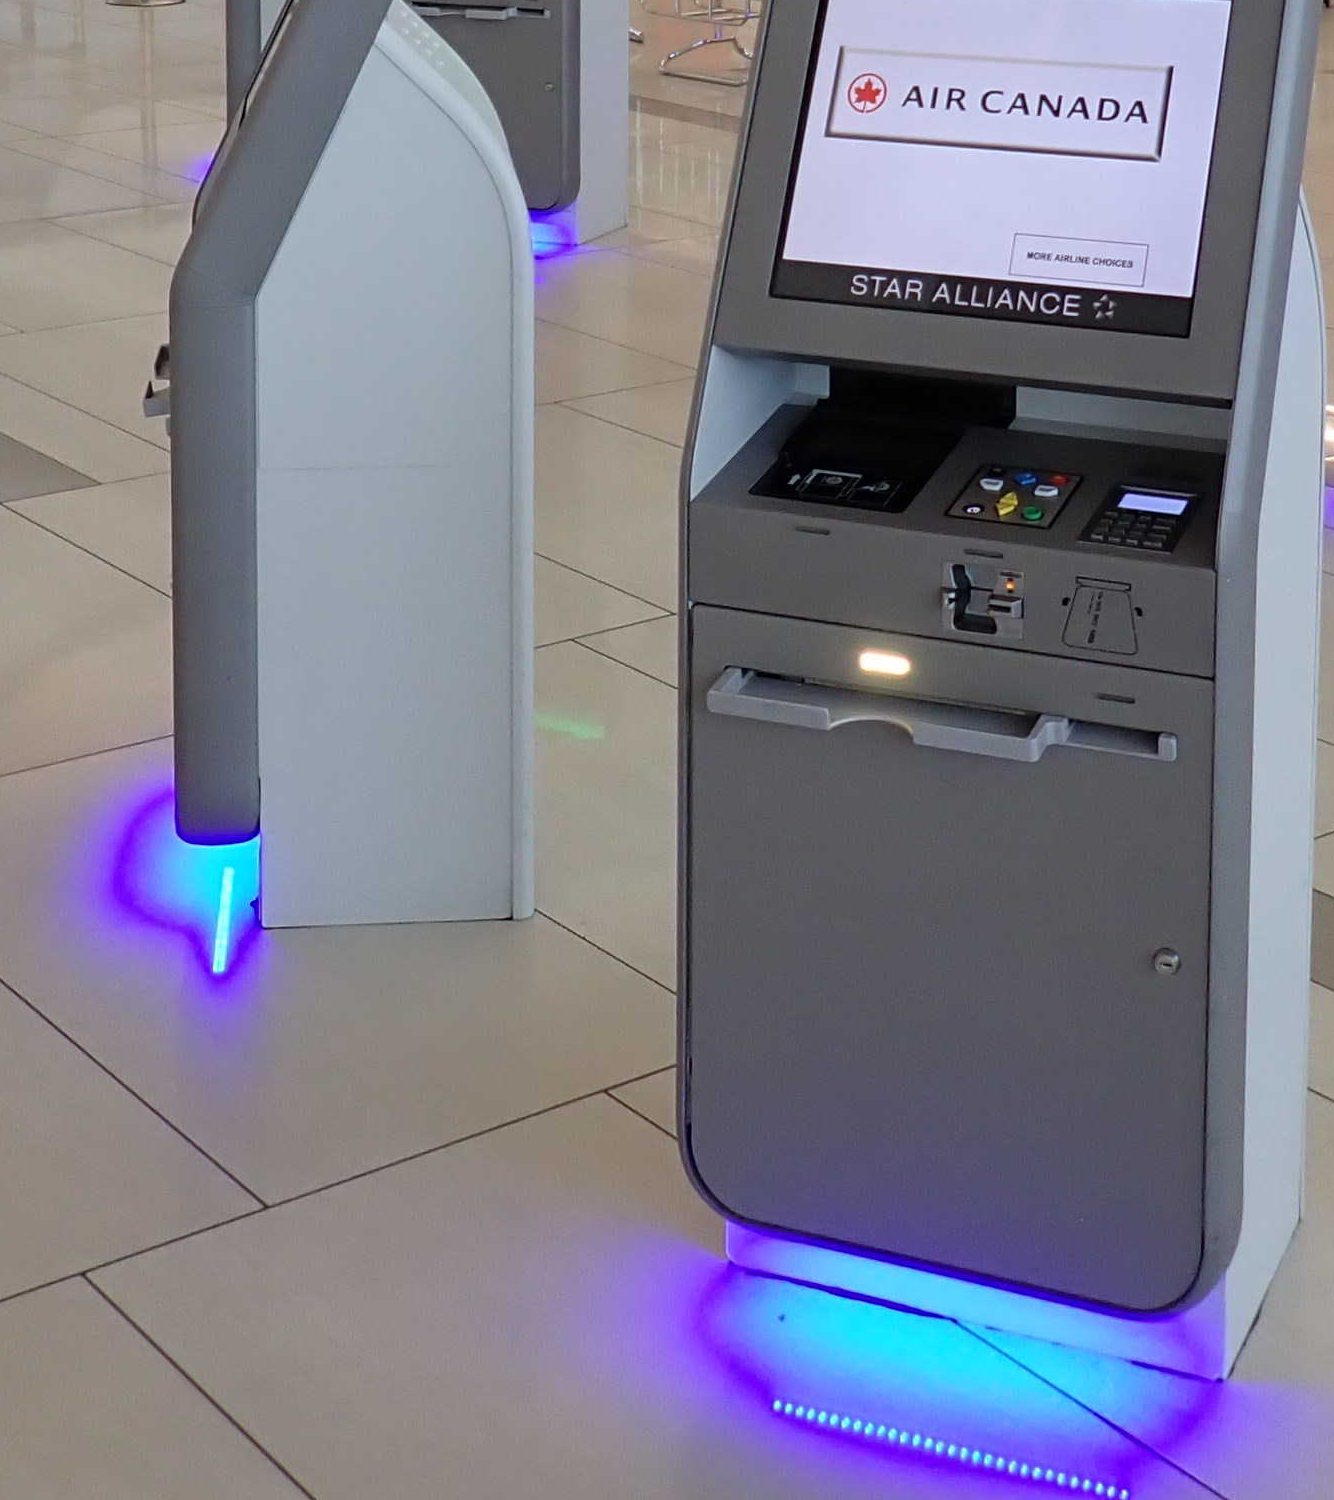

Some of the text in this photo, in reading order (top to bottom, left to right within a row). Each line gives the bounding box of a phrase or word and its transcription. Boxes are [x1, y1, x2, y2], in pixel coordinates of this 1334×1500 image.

[901, 85, 1149, 124] AIR CANADA
[1026, 251, 1134, 269] MORE AIRLINE CHOICES
[850, 273, 1083, 318] STAR ALLIANCE
